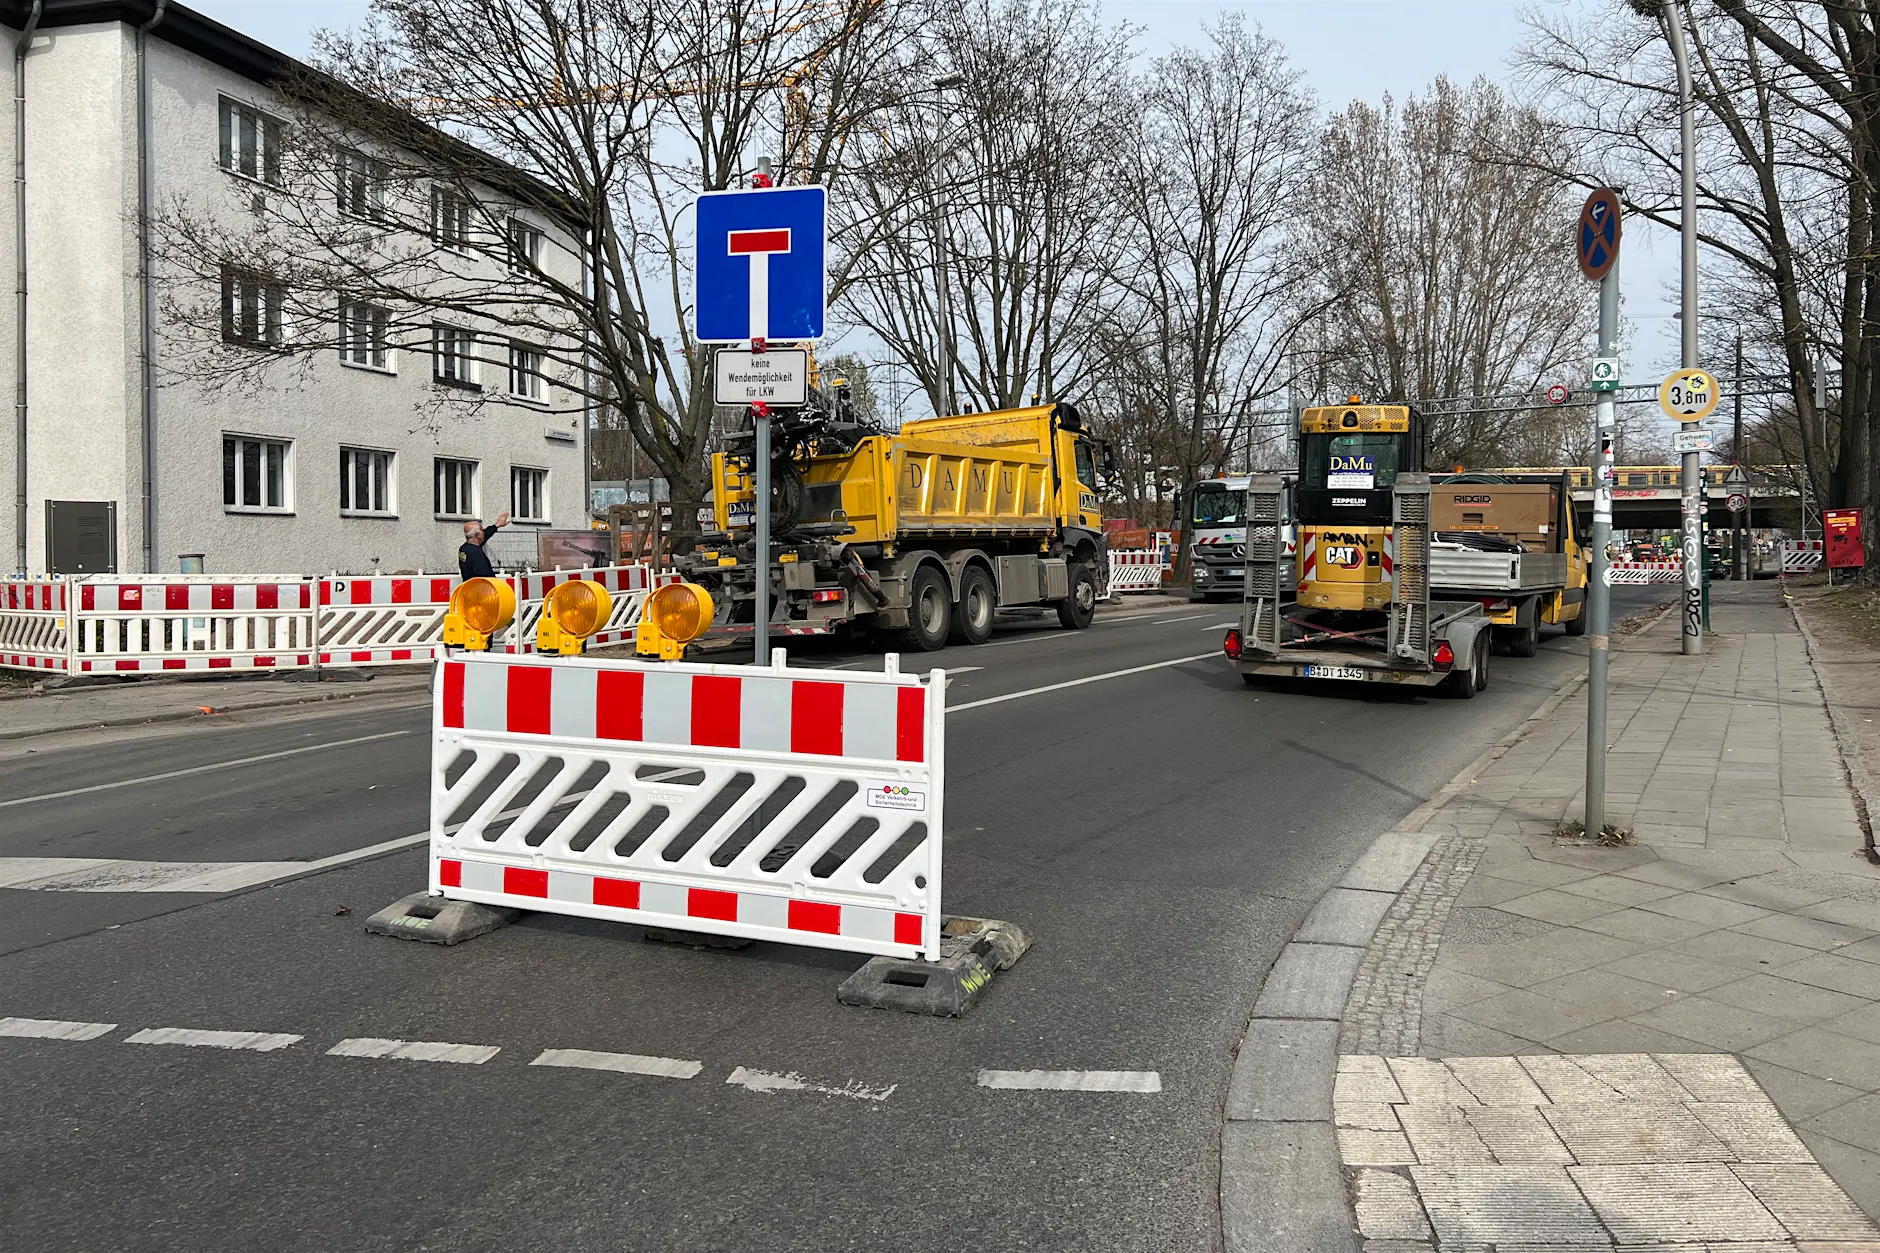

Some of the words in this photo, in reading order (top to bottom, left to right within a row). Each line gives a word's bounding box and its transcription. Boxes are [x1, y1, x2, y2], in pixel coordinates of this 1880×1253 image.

[751, 358, 770, 368] keine
[728, 372, 792, 384] Wendemöglichkeit
[746, 387, 757, 397] für
[759, 387, 774, 397] LKW
[1330, 456, 1373, 471] DaMu
[1454, 495, 1491, 503] RIDGID
[1730, 497, 1743, 508] 30
[1325, 547, 1355, 565] CAT
[1309, 666, 1316, 676] B
[1322, 667, 1335, 677] DT
[1337, 669, 1363, 679] 1345
[647, 788, 685, 804] nissen
